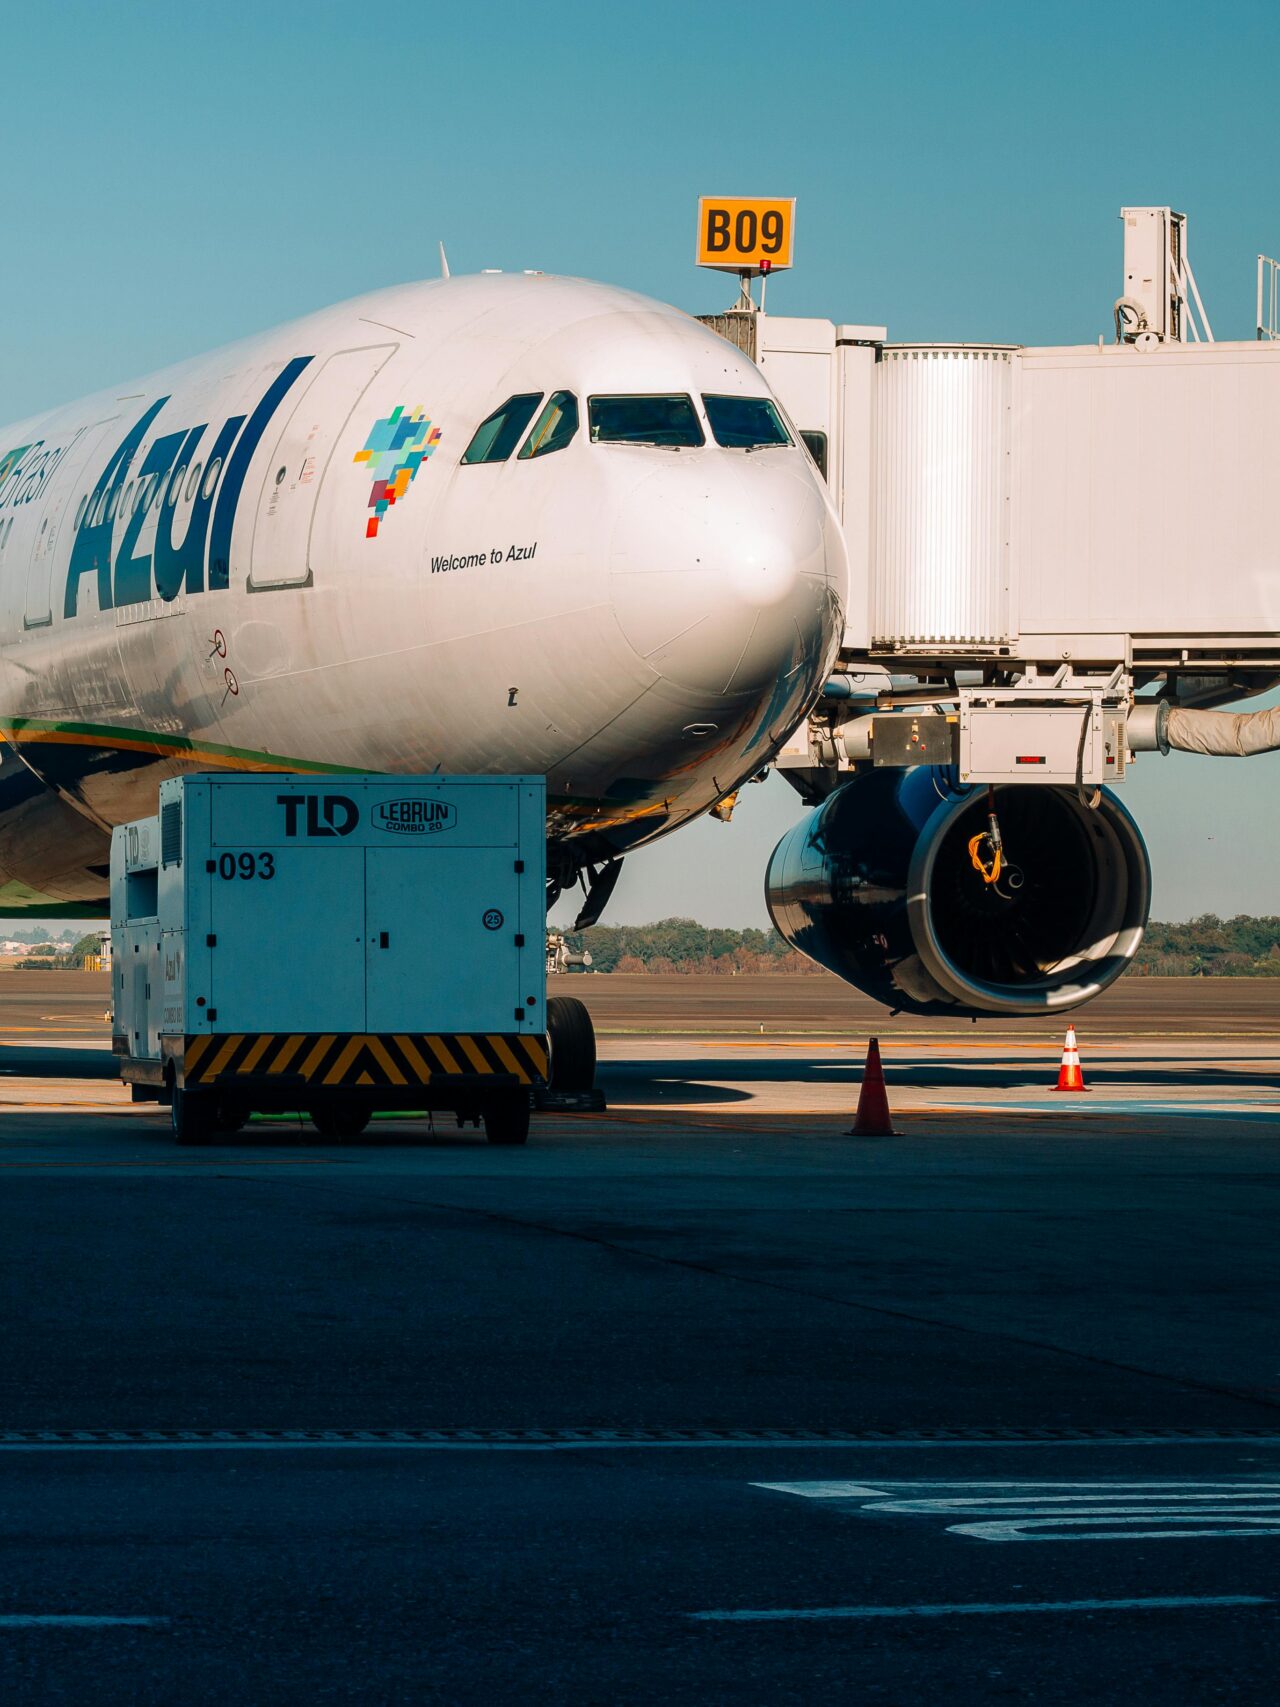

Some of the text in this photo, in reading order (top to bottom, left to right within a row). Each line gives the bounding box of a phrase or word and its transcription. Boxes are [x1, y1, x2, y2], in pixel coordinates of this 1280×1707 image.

[706, 209, 784, 254] B09
[64, 355, 316, 619] Azul
[431, 542, 537, 573] Welcome to Azul
[277, 795, 360, 837] TLD
[380, 801, 449, 823] LEBRUN
[386, 821, 443, 833] COMBO 20
[219, 851, 276, 881] 093
[486, 914, 501, 925] 25
